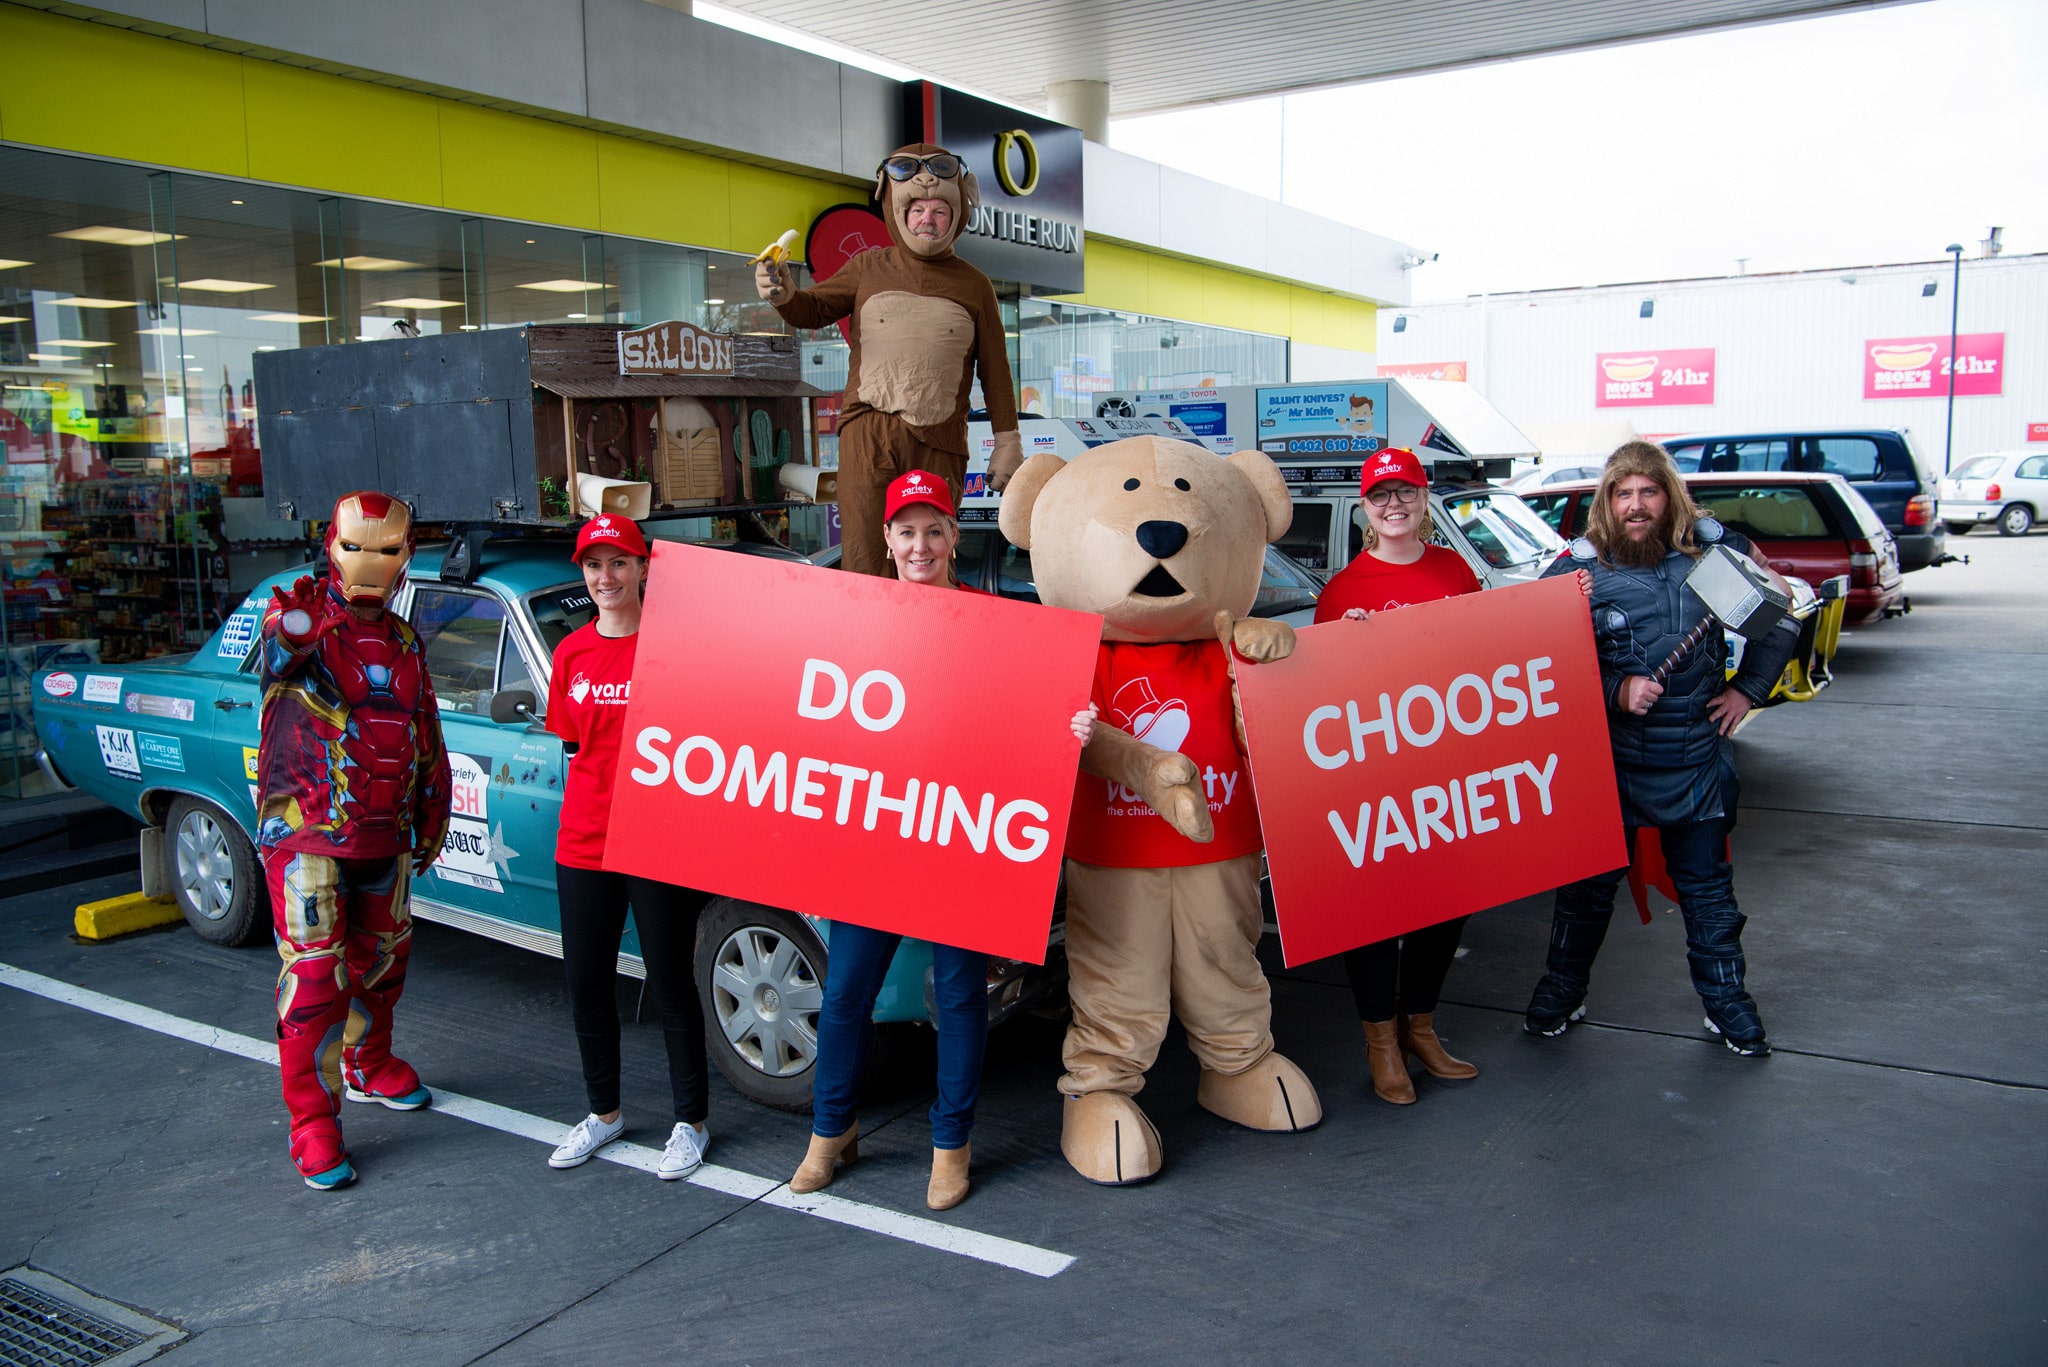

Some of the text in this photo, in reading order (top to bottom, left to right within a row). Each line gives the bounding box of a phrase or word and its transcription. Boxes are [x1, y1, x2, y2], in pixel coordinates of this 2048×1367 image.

[999, 208, 1037, 244] THE
[1041, 218, 1079, 253] RUN
[624, 326, 732, 371] SALOON
[1874, 370, 1931, 383] MOE'S
[1077, 378, 1112, 392] Lotteries
[1604, 381, 1653, 394] MOE'S
[1190, 390, 1218, 398] TOYOTA
[1269, 393, 1345, 405] BLUNT KNIVES?
[1288, 408, 1303, 418] Mr
[1306, 406, 1334, 417] Knife
[1115, 419, 1152, 430] CODAN
[1289, 437, 1378, 453] 0402 610 296
[1373, 463, 1402, 475] variety
[901, 485, 932, 495] variety
[590, 526, 620, 538] variety
[561, 596, 592, 609] Tim
[238, 617, 255, 641] 9
[220, 642, 249, 656] NEWS
[97, 680, 119, 691] TOYOTA
[797, 658, 906, 732] DO
[1303, 656, 1560, 770] CHOOSE
[107, 730, 132, 754] KJK
[145, 742, 179, 755] CARPET ONE
[112, 753, 137, 770] LEGAL
[631, 726, 1050, 863] SOMETHING
[1107, 805, 1124, 816] the
[1327, 753, 1559, 868] VARIETY
